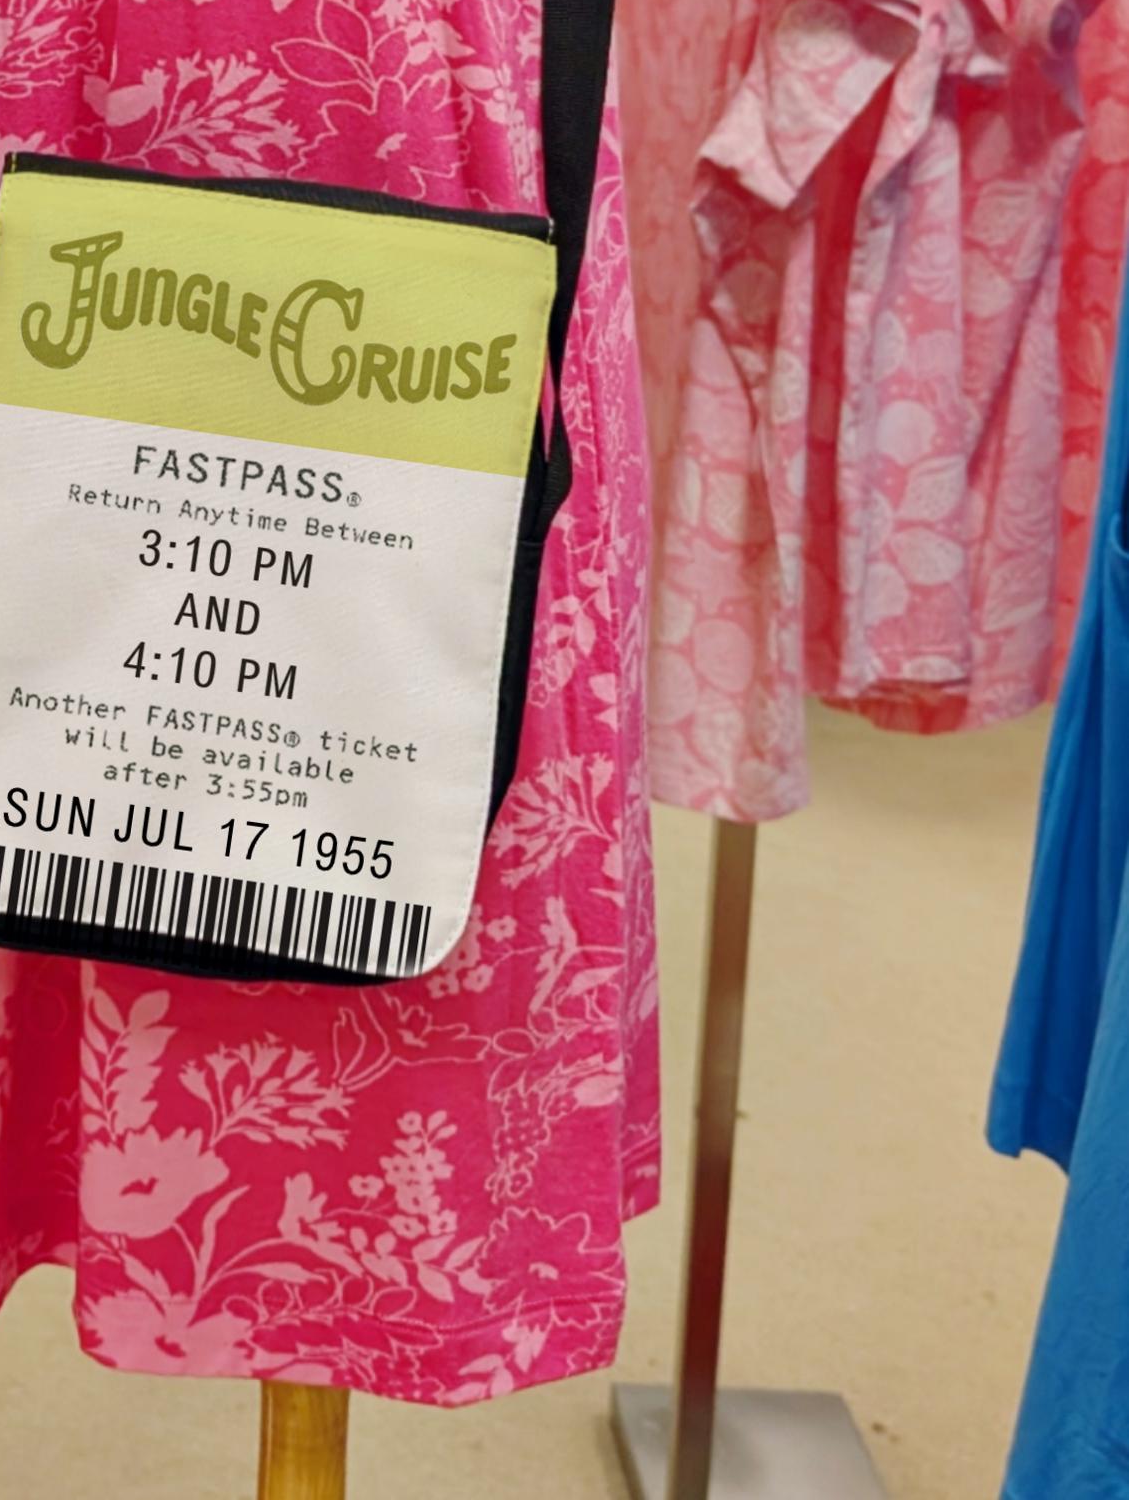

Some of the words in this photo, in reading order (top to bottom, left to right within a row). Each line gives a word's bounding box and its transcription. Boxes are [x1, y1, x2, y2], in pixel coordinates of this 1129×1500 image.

[20, 230, 269, 370] JUNGLE
[270, 279, 518, 406] CRUISE
[68, 483, 163, 515] Return
[177, 499, 288, 533] Anytime
[304, 516, 415, 550] Between
[138, 528, 233, 577] 3:10
[252, 546, 314, 589] PM
[173, 591, 262, 637] AND
[122, 640, 217, 689] 4:10
[235, 657, 298, 700] PM
[8, 686, 127, 721] Another
[319, 729, 419, 763] ticket
[64, 726, 130, 754] will
[150, 735, 185, 760] be
[201, 747, 356, 785] available
[103, 761, 188, 791] after
[205, 773, 309, 809] 3:55pm
[2, 786, 96, 838] SUN
[113, 803, 194, 852] JUL
[219, 817, 270, 861] 17
[290, 828, 396, 880] 1955
